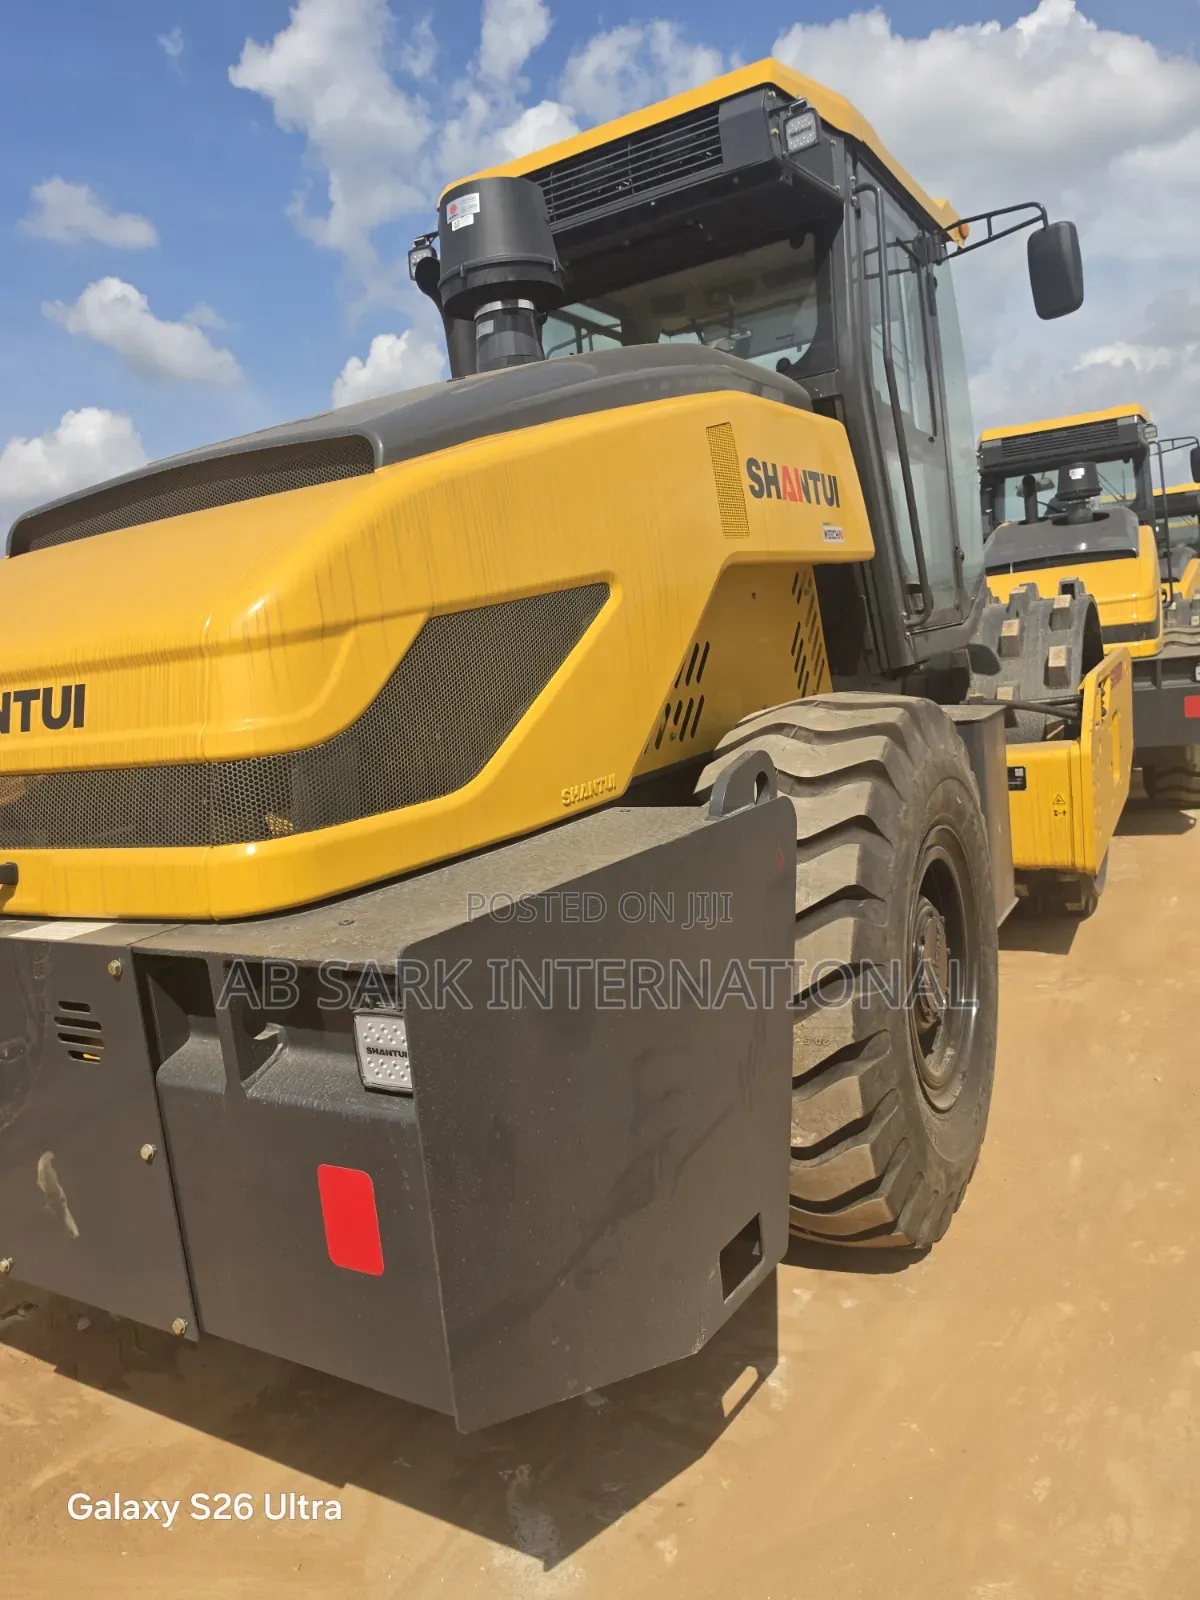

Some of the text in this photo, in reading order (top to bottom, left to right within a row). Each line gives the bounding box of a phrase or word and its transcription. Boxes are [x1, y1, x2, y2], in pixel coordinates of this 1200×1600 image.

[746, 457, 840, 508] SHANTUI
[561, 773, 616, 807] SHANTUI
[366, 1046, 408, 1058] SHANTUI
